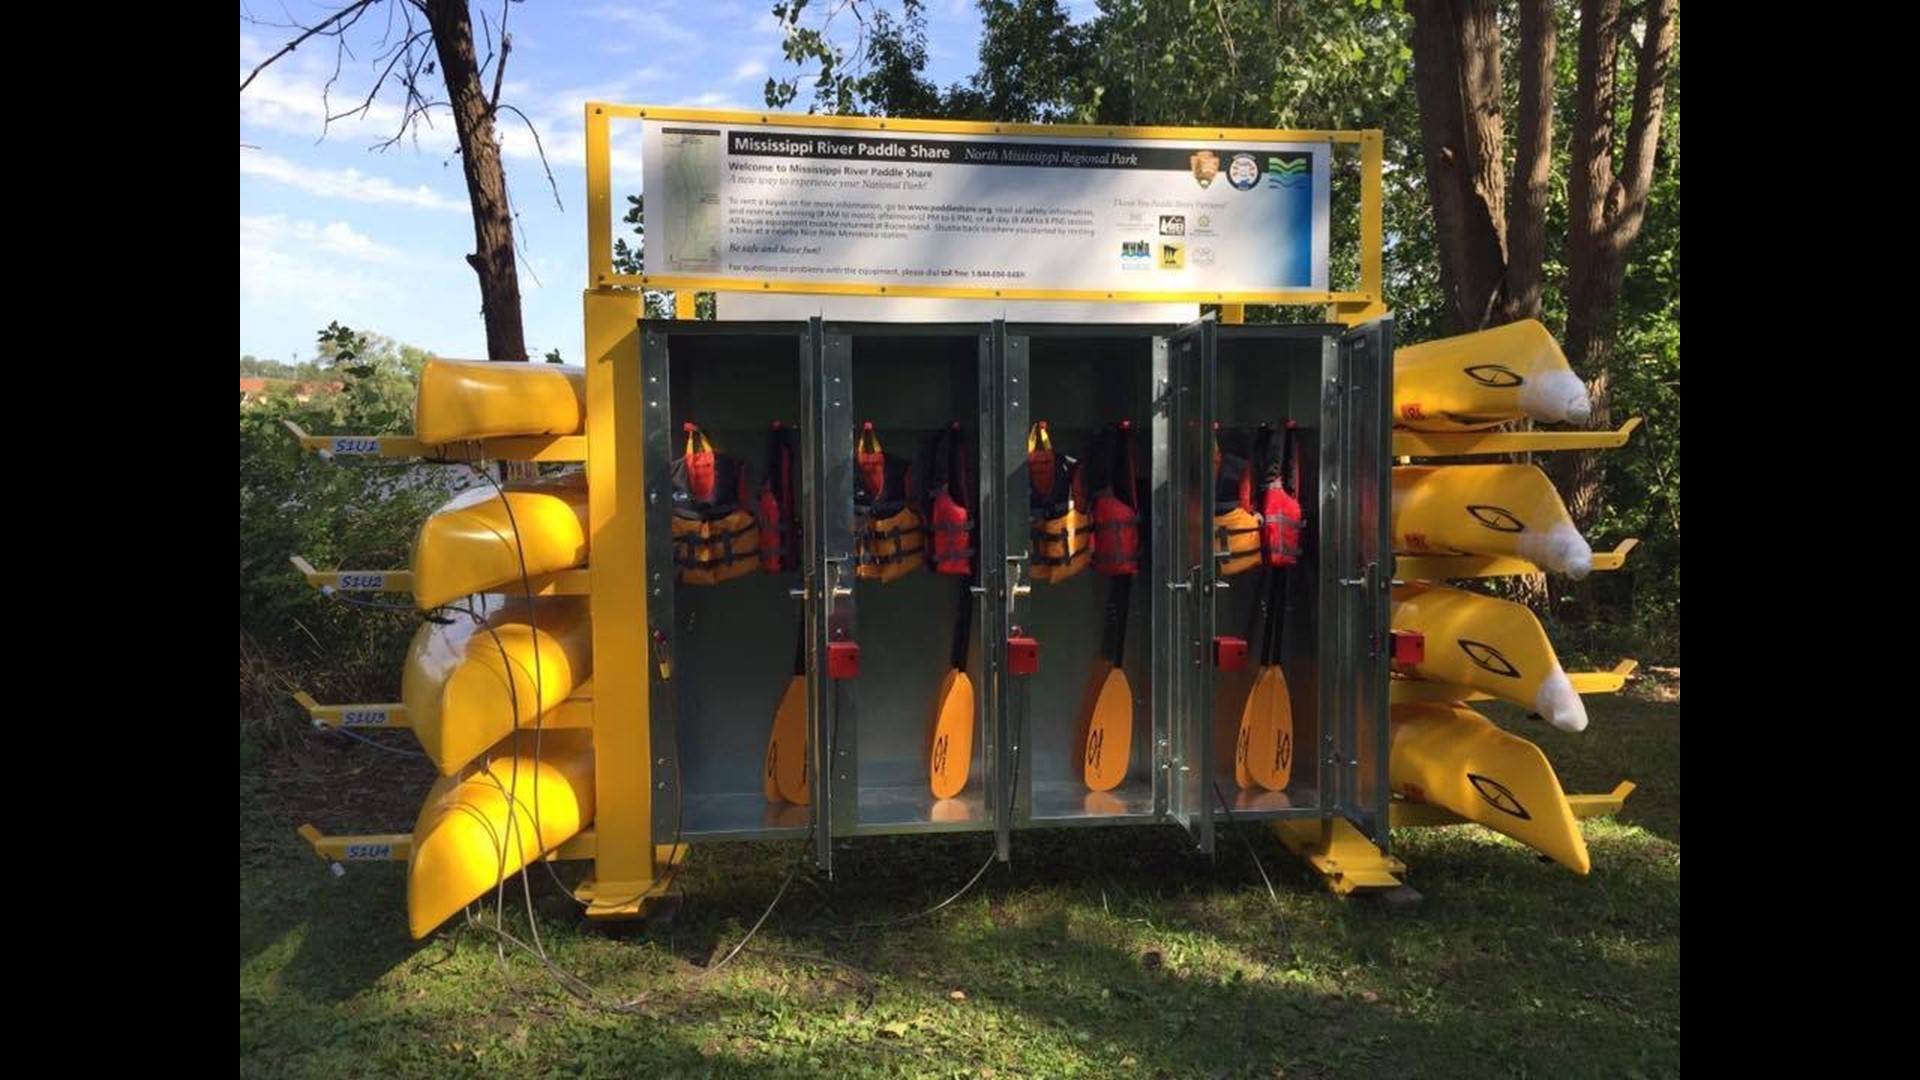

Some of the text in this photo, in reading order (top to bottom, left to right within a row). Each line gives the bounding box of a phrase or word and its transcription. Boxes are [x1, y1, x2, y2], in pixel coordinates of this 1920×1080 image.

[734, 137, 950, 158] Mississippi River Paddle Share
[965, 148, 1138, 166] North Mississippi Regional Park
[728, 162, 932, 178] Welcome to Mississippi River Paddle Share
[729, 174, 736, 183] A
[758, 177, 778, 187] way
[780, 177, 790, 185] to
[790, 178, 837, 188] experience
[839, 180, 861, 190] your
[863, 180, 900, 190] National
[765, 199, 787, 208] kayak
[741, 218, 763, 226] kayak
[765, 219, 808, 228] equipment
[838, 221, 874, 229] returned
[772, 228, 799, 237] nearby
[729, 243, 740, 252] Be
[742, 244, 760, 254] safe
[760, 244, 779, 253] and
[780, 244, 801, 254] have
[743, 264, 778, 272] questions
[790, 266, 824, 274] problems
[902, 268, 924, 278] please
[336, 440, 377, 452] S1U1
[341, 576, 382, 588] S1U2
[344, 711, 386, 724] S1U3
[348, 844, 390, 858] S1U4
